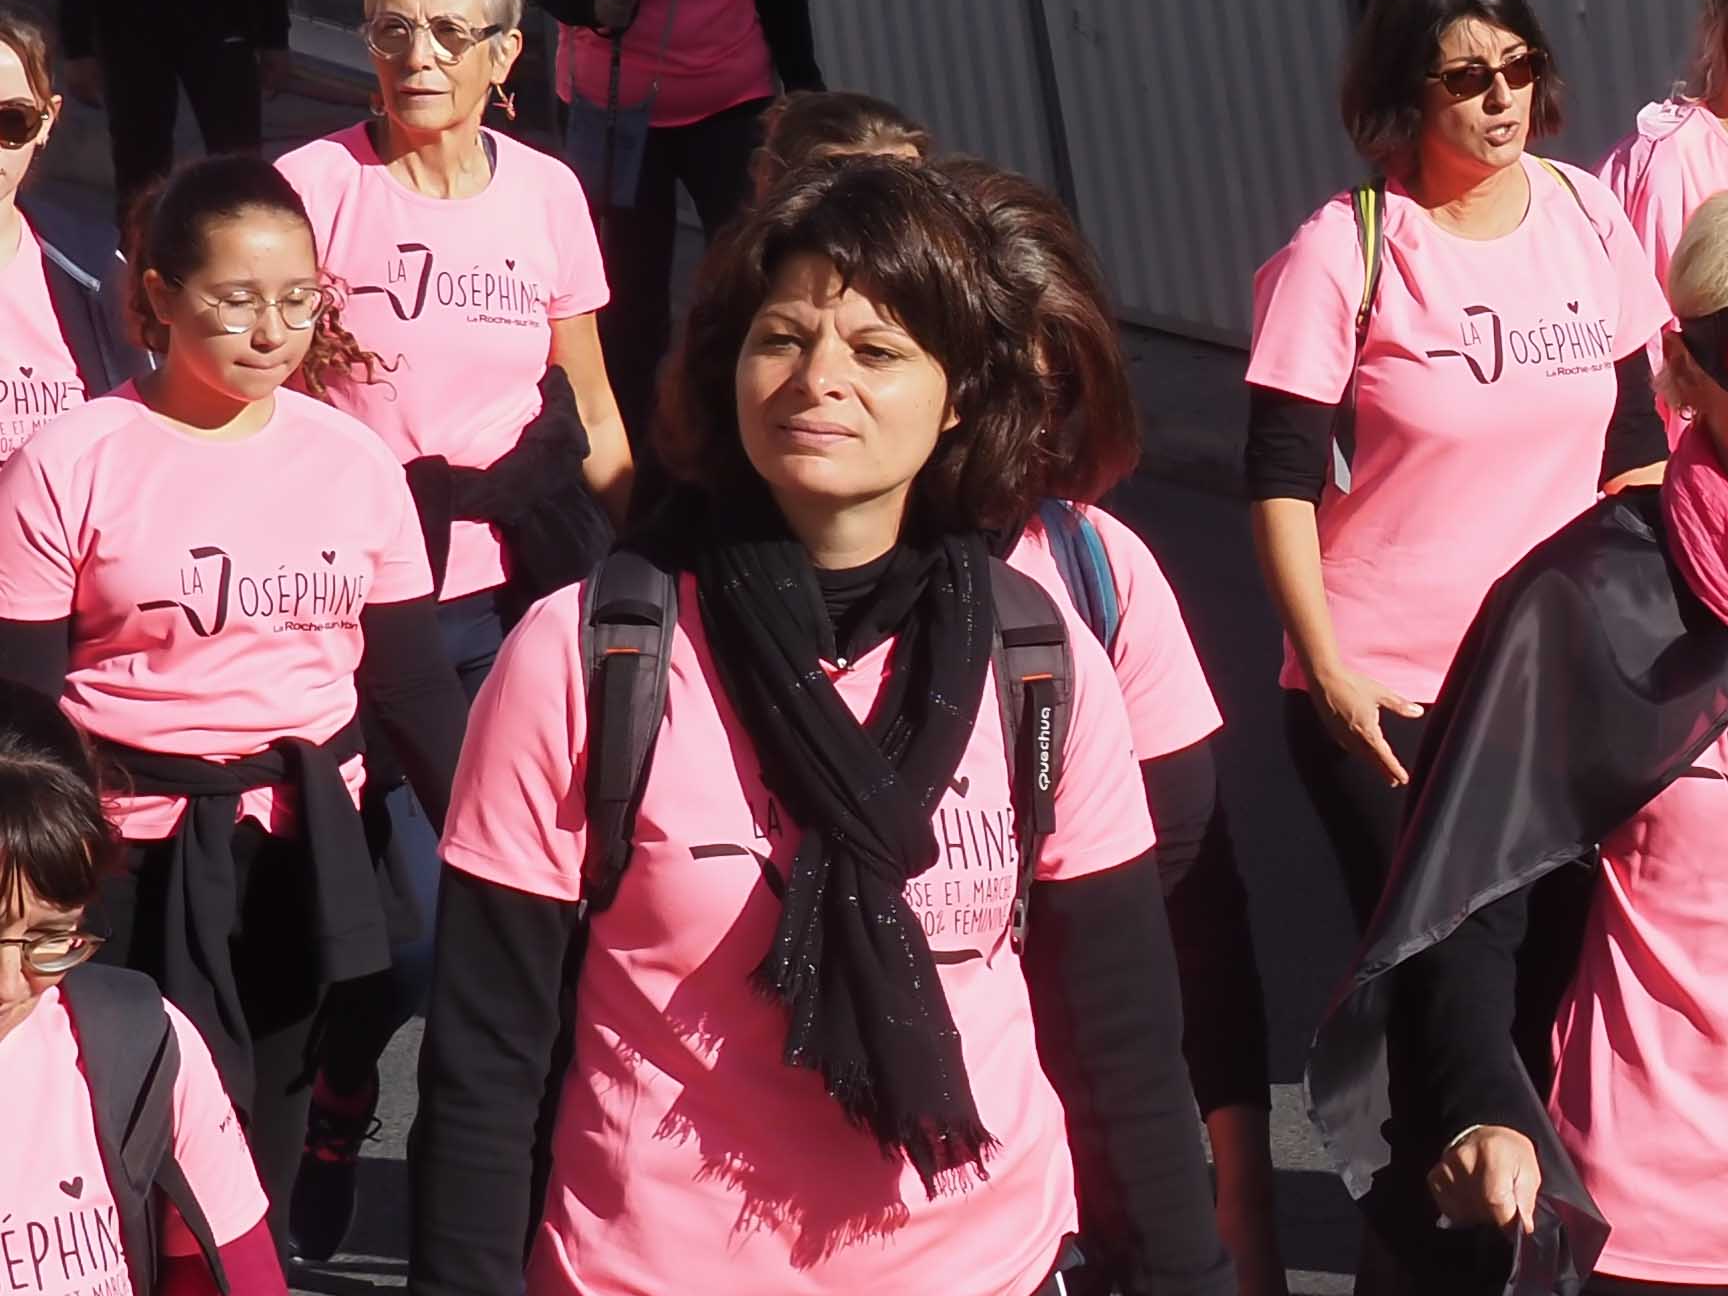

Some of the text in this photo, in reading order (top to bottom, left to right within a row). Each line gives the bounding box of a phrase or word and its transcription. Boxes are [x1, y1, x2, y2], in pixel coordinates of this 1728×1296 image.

[388, 259, 407, 283] LA
[1460, 321, 1482, 346] LA
[180, 566, 204, 595] LA
[1038, 706, 1052, 791] Quechua
[753, 797, 784, 839] LA
[944, 880, 961, 906] ET
